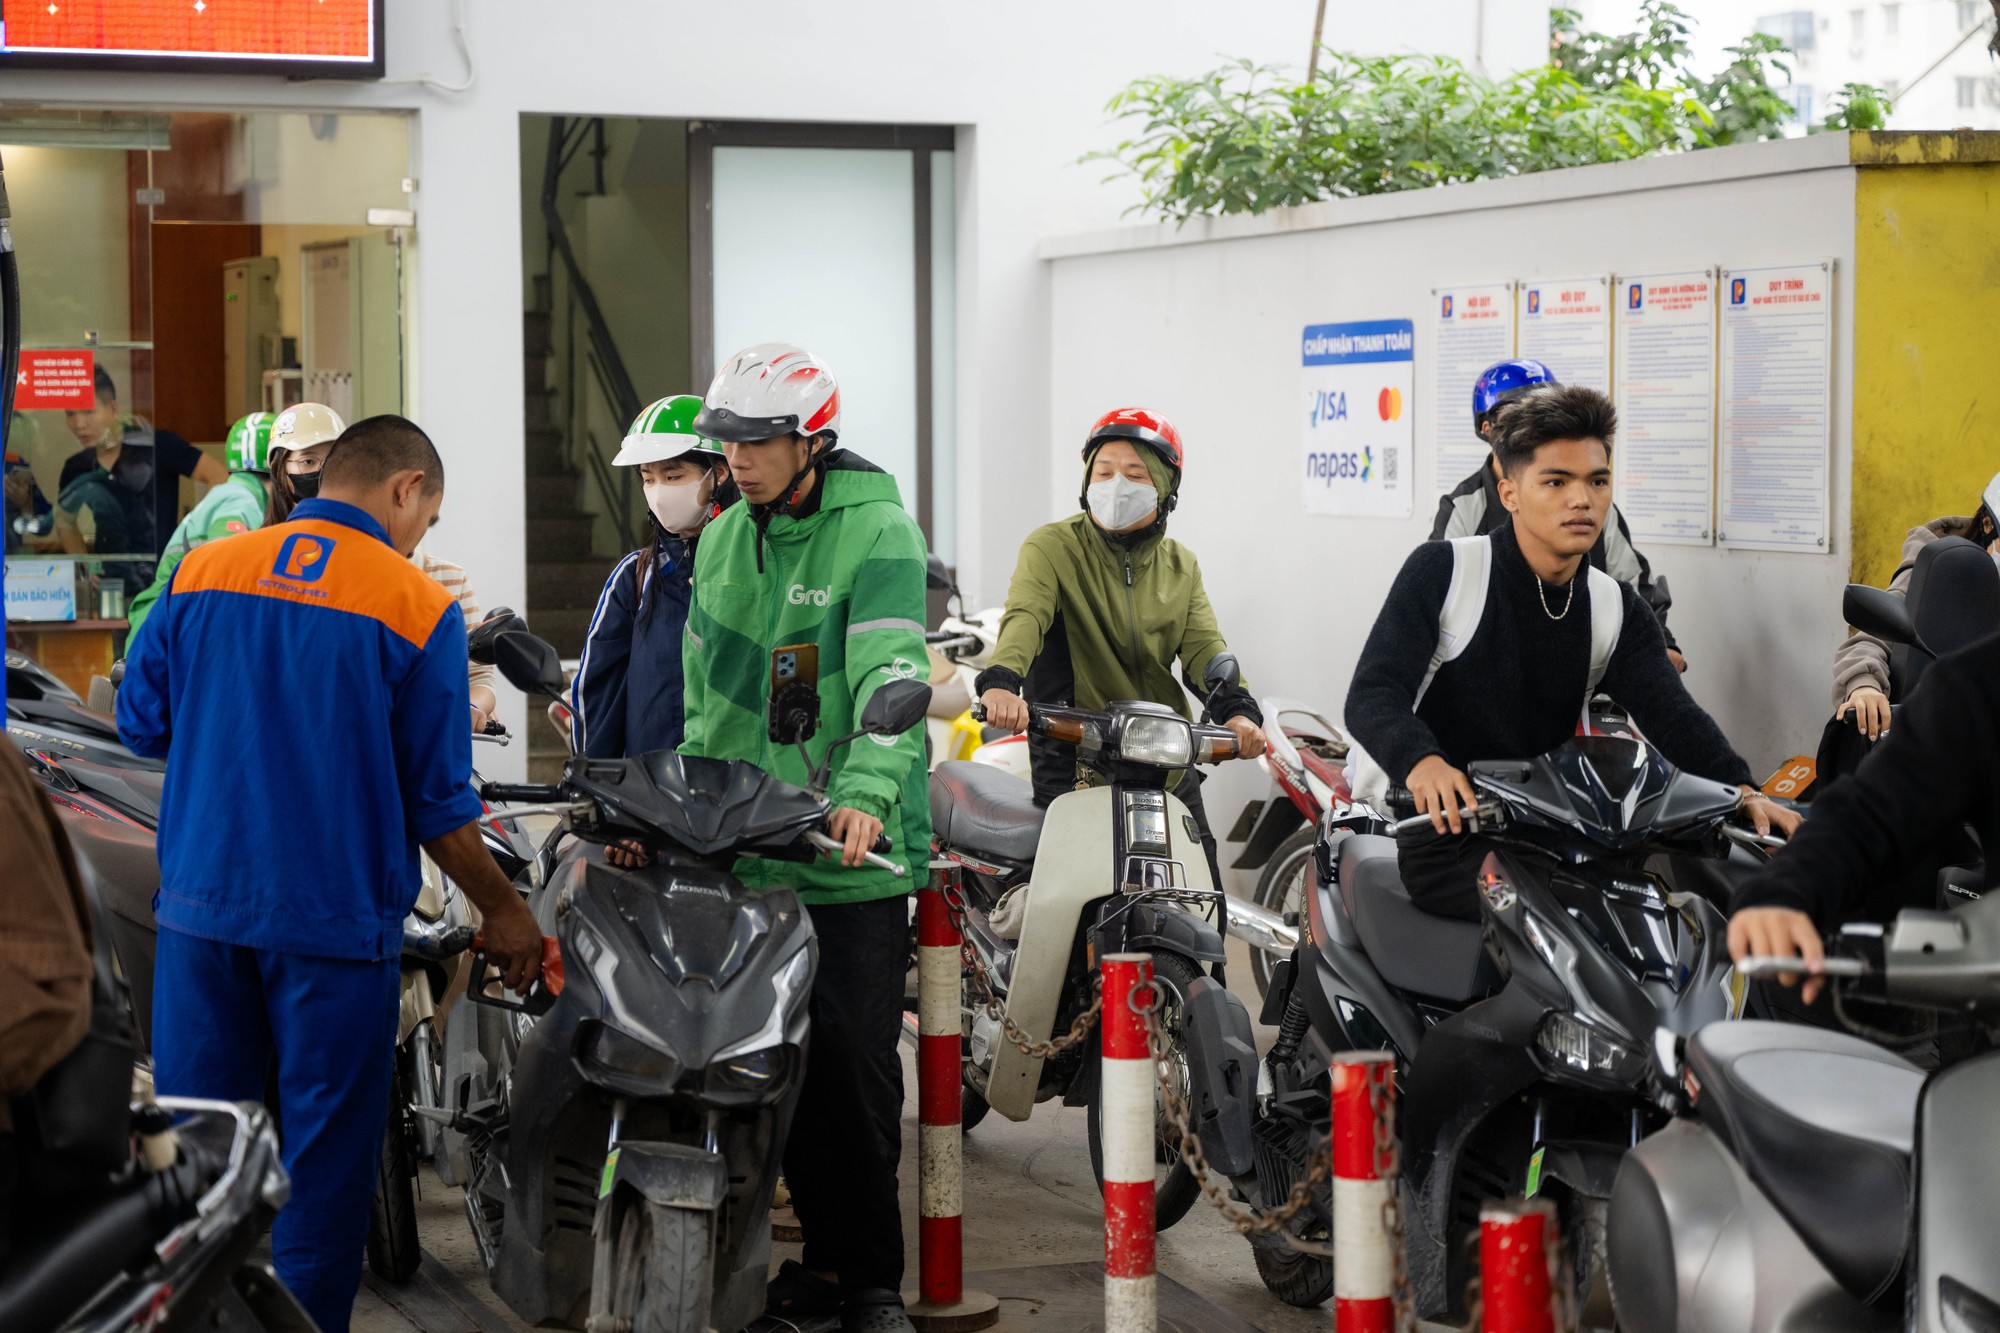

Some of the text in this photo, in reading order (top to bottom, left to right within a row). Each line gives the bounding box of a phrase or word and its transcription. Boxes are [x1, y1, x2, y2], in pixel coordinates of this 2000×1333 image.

[1304, 329, 1411, 357] CHẤP NHẬN THANH TOÁN
[1307, 452, 1358, 488] napas
[258, 578, 328, 599] PETROLIMEX
[960, 856, 979, 869] HONDA
[1948, 883, 1983, 900] SPO
